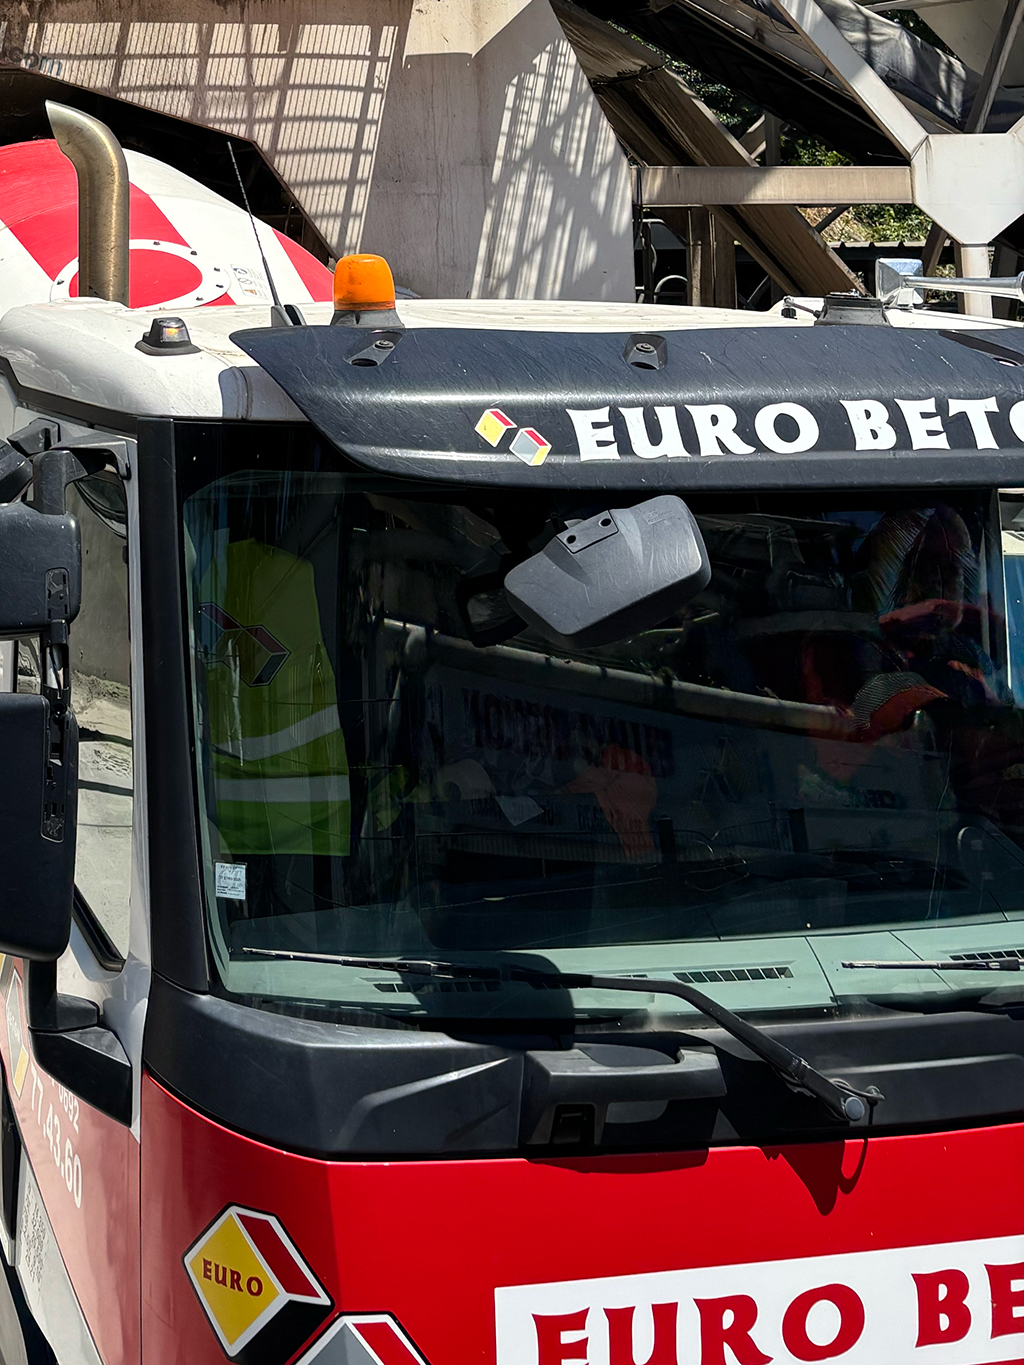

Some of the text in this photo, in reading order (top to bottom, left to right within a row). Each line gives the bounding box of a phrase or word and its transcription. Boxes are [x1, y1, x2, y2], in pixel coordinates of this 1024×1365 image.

[565, 396, 1024, 462] EURO BET
[202, 1257, 264, 1297] EURO
[531, 1282, 866, 1365] EURO
